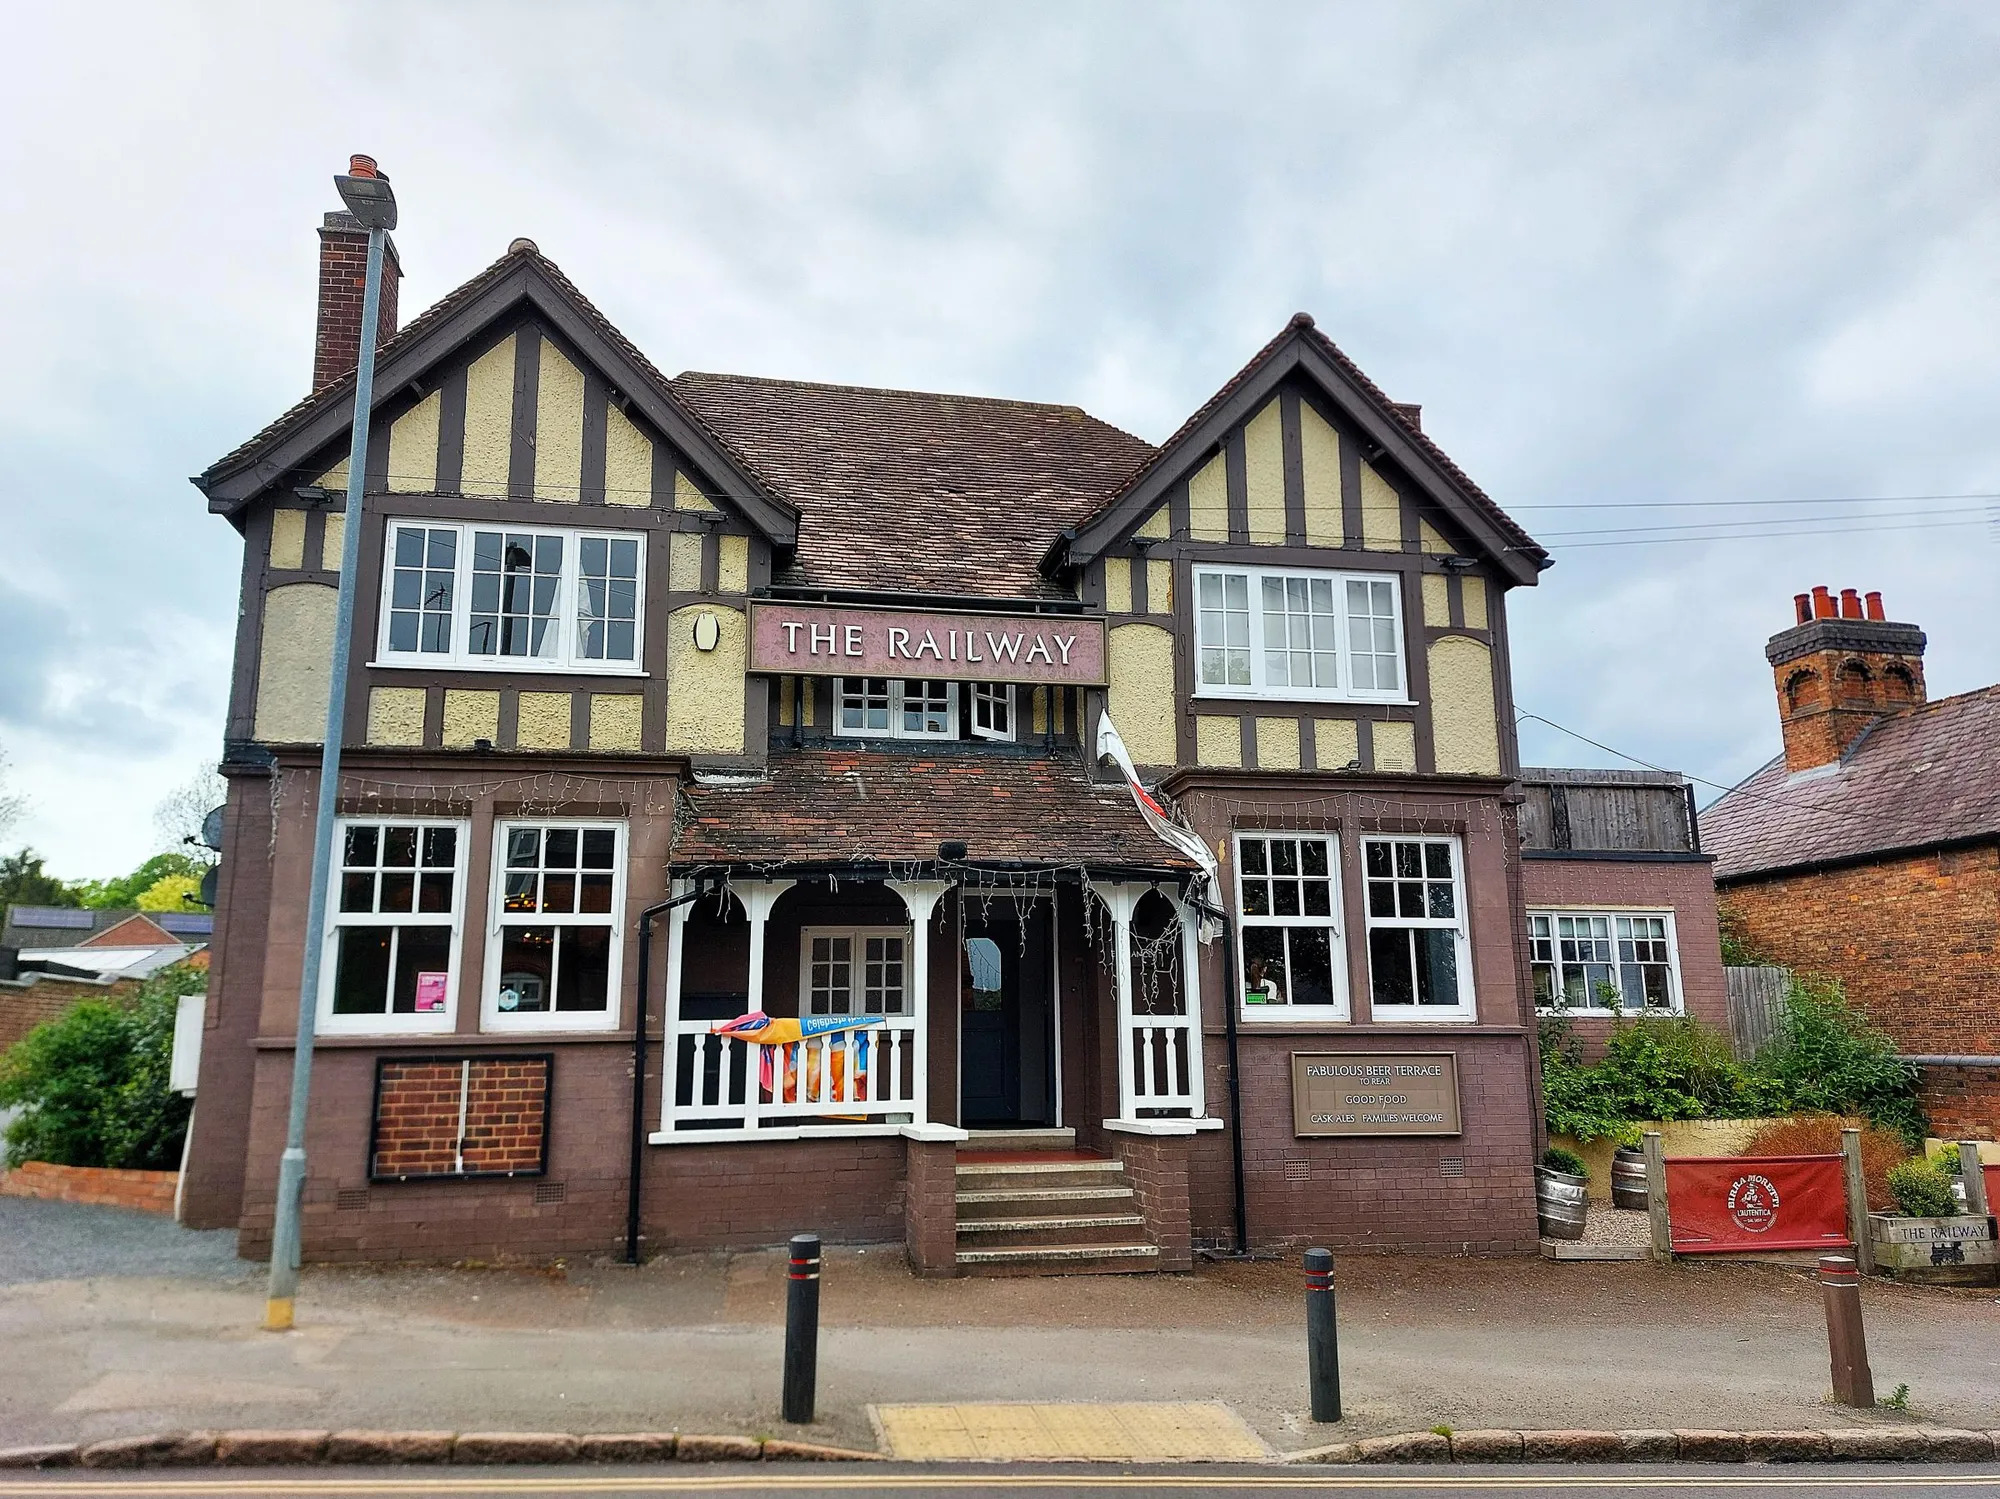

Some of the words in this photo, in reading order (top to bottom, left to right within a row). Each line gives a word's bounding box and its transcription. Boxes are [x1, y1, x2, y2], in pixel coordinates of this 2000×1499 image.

[781, 621, 863, 657] THE
[887, 627, 1078, 665] RAILWAY
[1307, 1065, 1363, 1076] FABULOUS
[1366, 1066, 1392, 1076] BEER
[1395, 1066, 1442, 1076] TERRACE
[1345, 1095, 1376, 1104] GOOD
[1379, 1095, 1407, 1104] FOOD
[1310, 1114, 1334, 1123] CASK
[1336, 1114, 1355, 1123] ALES
[1362, 1114, 1399, 1123] FAMILIES
[1400, 1113, 1443, 1122] WELCOME
[1728, 1177, 1747, 1209] BIRRA
[1747, 1174, 1780, 1208] MORETTI
[1901, 1228, 1925, 1240] THE
[1931, 1226, 1985, 1239] RAILWAY
